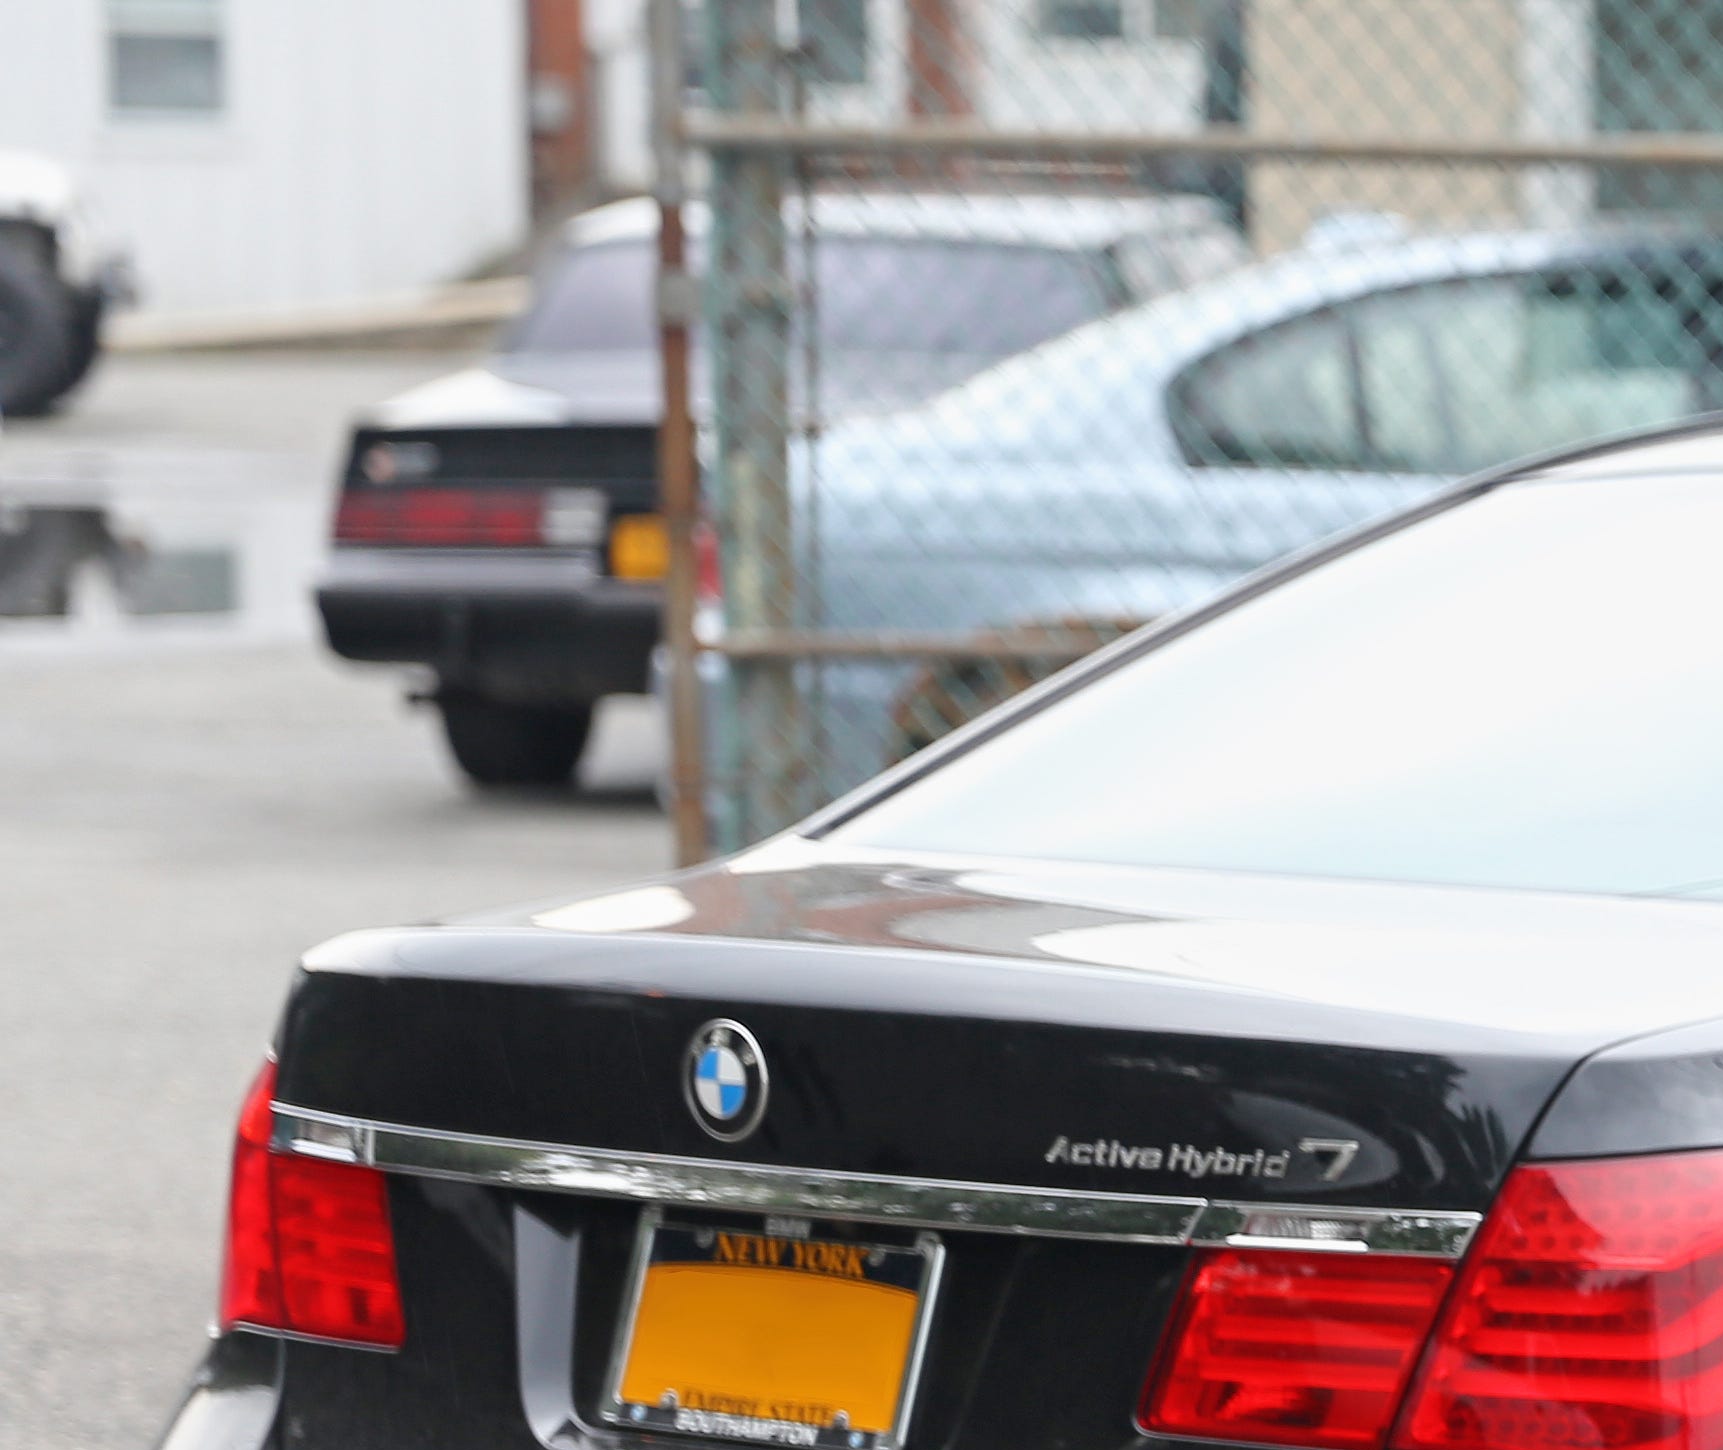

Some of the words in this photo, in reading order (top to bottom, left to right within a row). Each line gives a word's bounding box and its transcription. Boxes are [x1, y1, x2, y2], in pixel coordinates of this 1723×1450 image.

[1298, 1137, 1359, 1182] 7
[714, 1231, 787, 1267] NEW
[792, 1239, 868, 1281] YORK
[674, 1407, 819, 1447] SOUTHAMPTON
